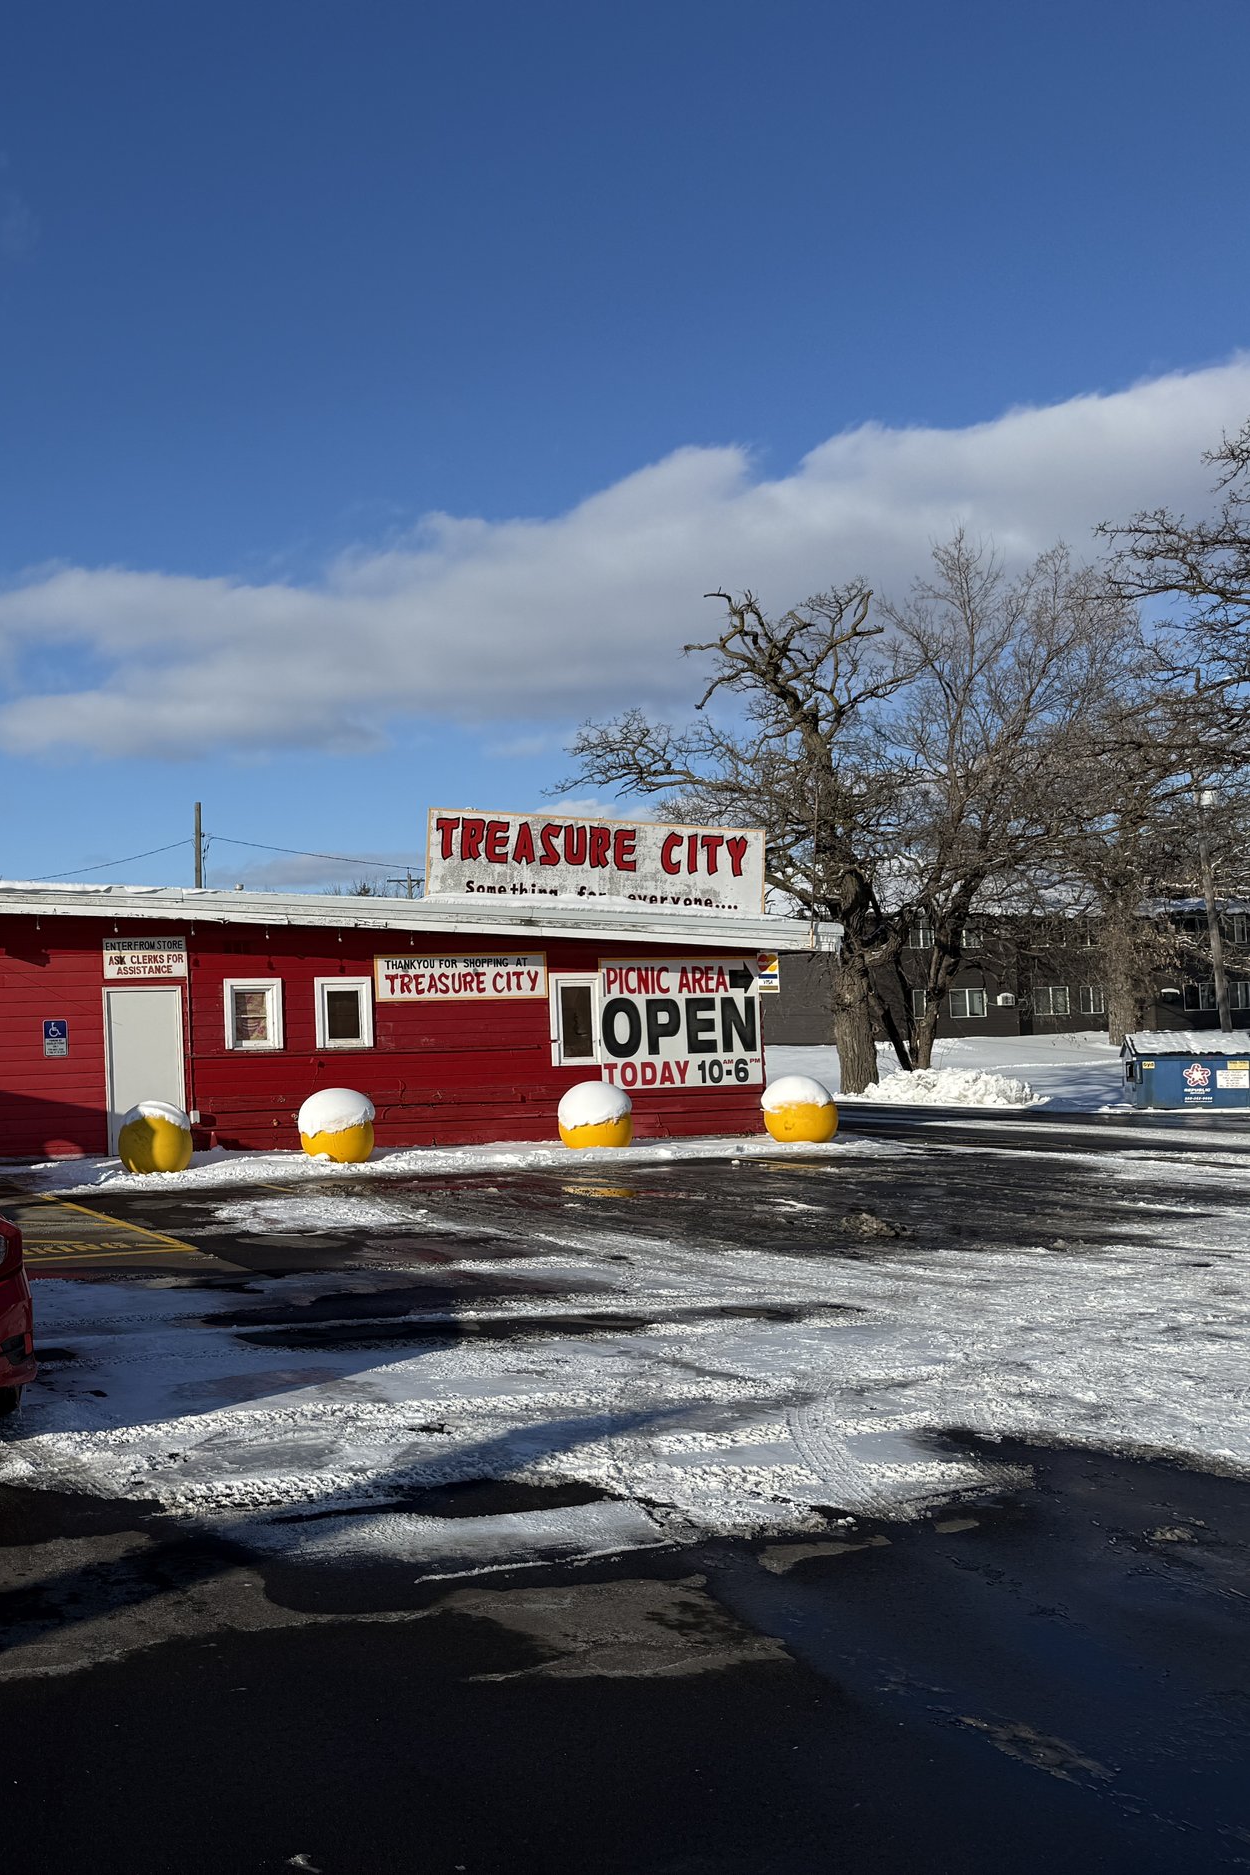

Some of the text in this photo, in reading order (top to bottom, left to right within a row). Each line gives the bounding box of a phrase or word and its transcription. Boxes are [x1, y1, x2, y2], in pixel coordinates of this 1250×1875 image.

[436, 816, 748, 878] TREASURE CITY
[105, 939, 183, 951] ENTER FROM STORE
[108, 953, 184, 966] ASK CLERKS FOR
[116, 965, 173, 976] ASSISTANCE
[439, 958, 458, 969] FOR
[463, 957, 509, 968] SHOPPING
[515, 957, 528, 967] AT
[384, 969, 539, 996] TREASURE CITY
[606, 965, 729, 995] PICNIC AREA
[602, 996, 758, 1059] OPEN
[603, 1060, 690, 1088] TODAY
